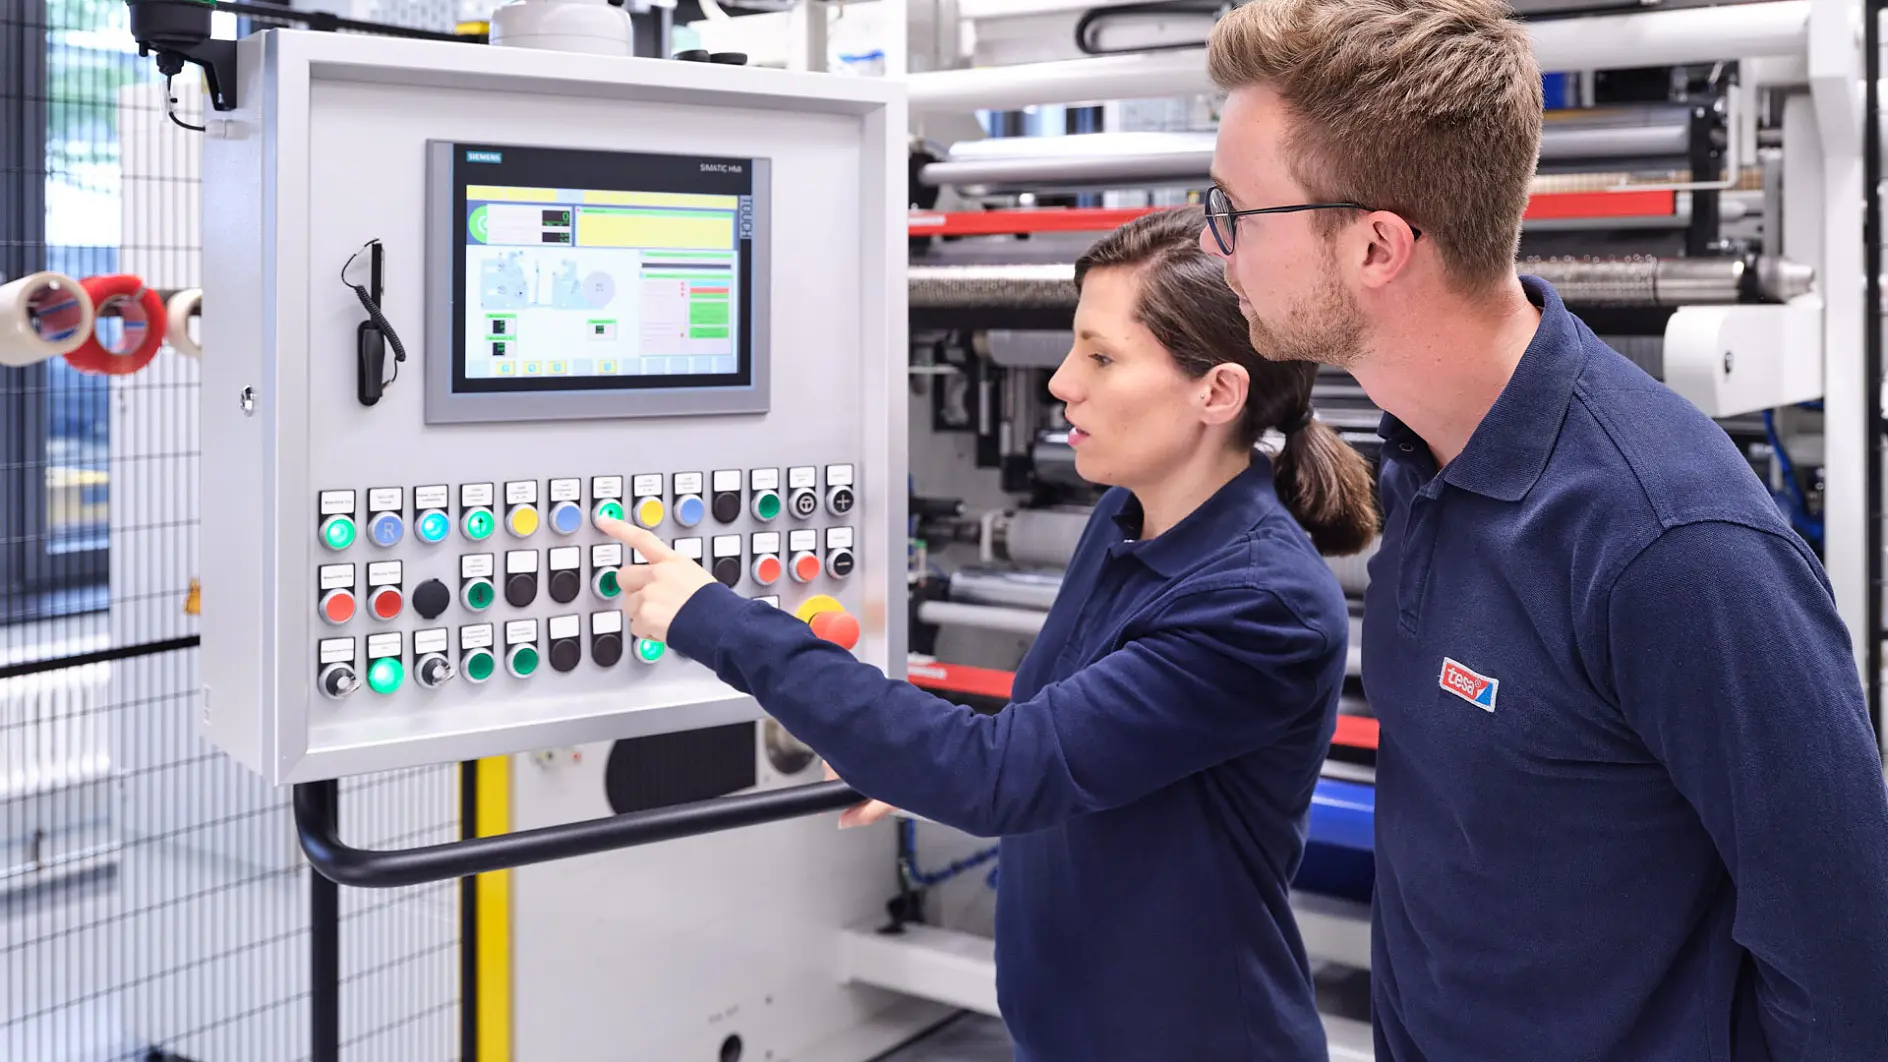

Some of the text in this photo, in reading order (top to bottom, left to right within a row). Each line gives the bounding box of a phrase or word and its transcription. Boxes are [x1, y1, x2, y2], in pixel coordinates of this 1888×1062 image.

[468, 152, 500, 161] SIEMENS
[700, 163, 728, 173] SIMATIC
[741, 196, 752, 239] TOUCH
[383, 521, 395, 540] R
